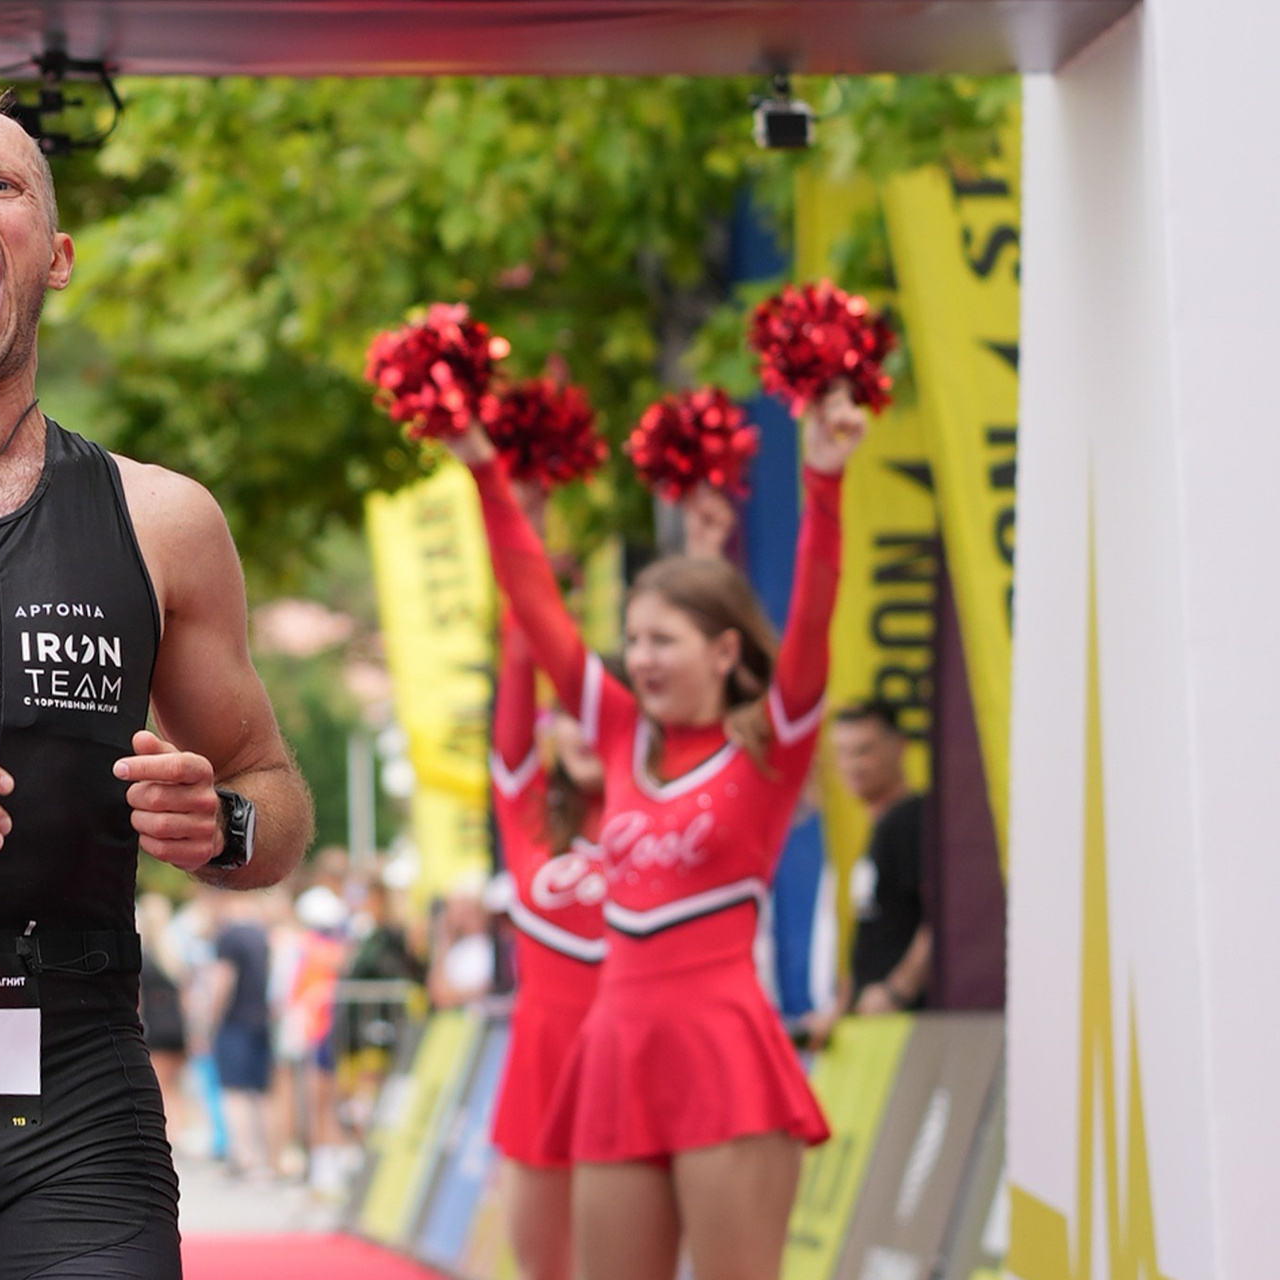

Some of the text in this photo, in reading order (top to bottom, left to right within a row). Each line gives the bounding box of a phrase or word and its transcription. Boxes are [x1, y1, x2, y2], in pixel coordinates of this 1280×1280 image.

[14, 602, 105, 619] APTONIA
[21, 631, 122, 668] IRON
[24, 668, 123, 702] TEAM
[97, 703, 119, 714] КЛУБ
